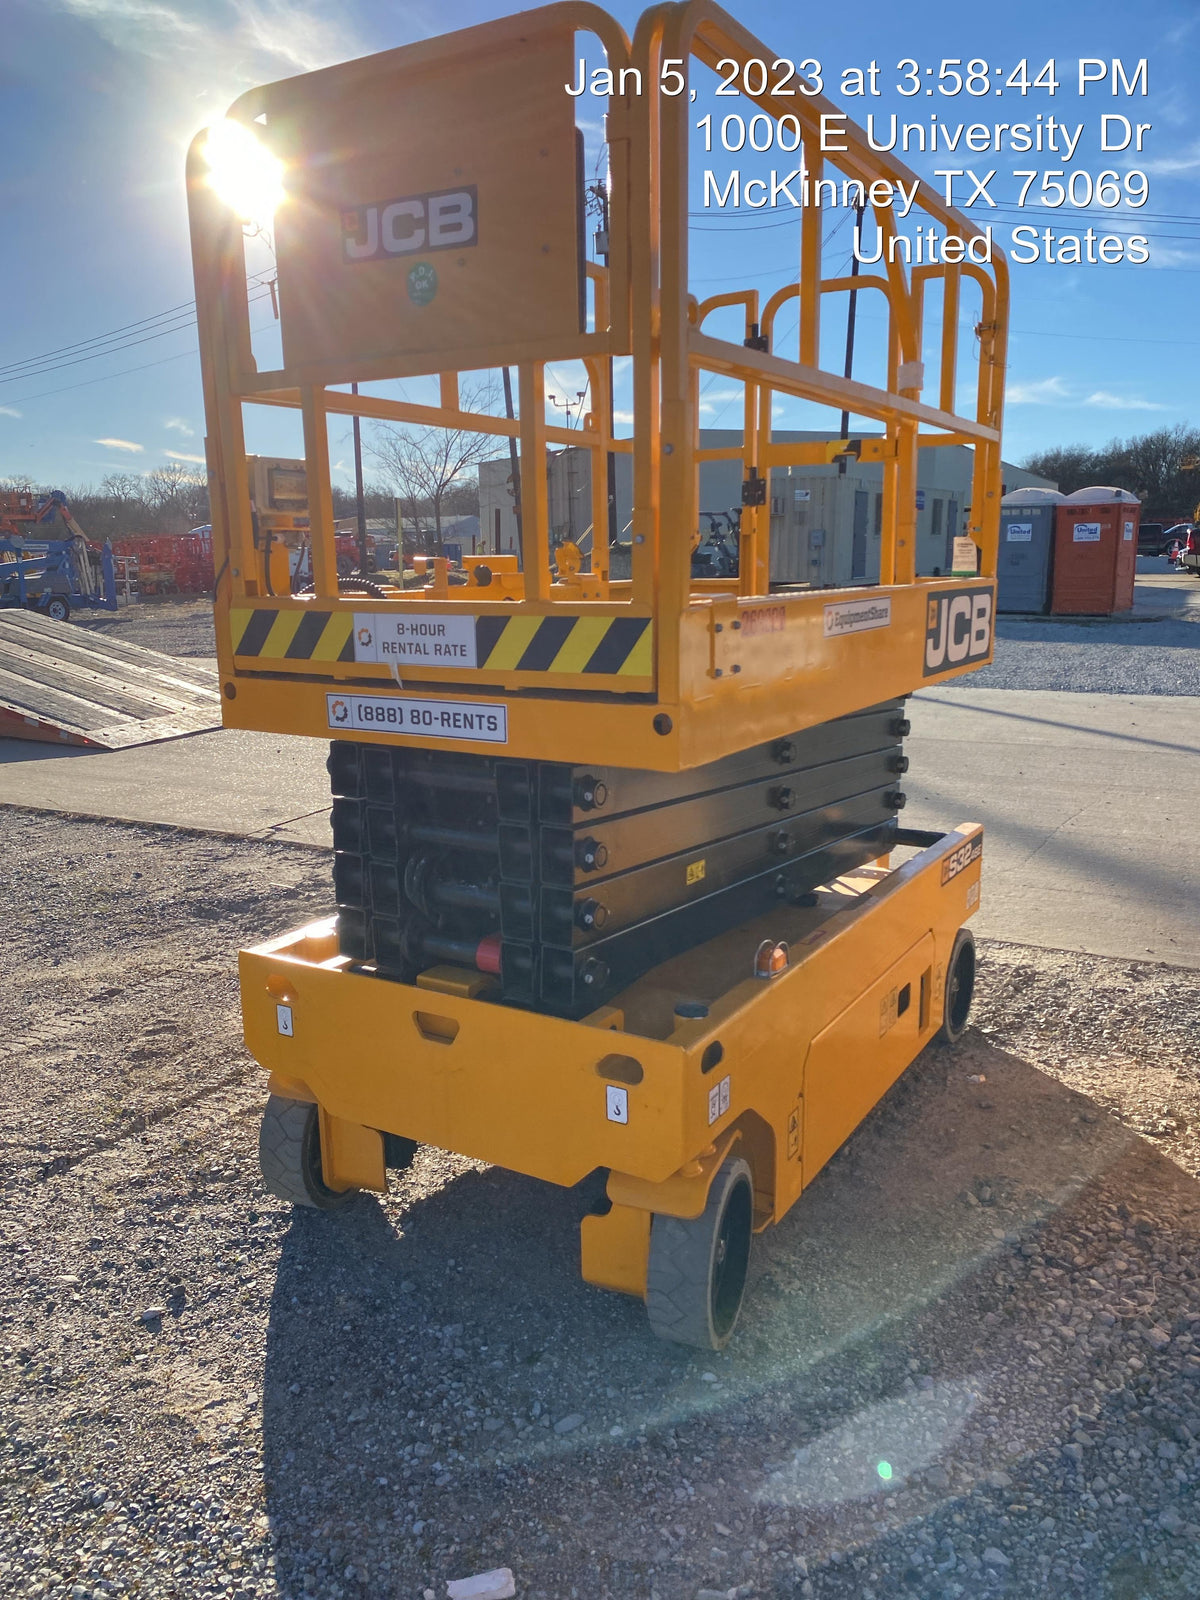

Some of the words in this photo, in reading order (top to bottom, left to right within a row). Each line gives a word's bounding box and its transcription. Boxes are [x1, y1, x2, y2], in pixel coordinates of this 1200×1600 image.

[345, 192, 475, 259] JCB
[1076, 526, 1098, 534] United
[396, 623, 446, 637] 8-HOUR
[834, 606, 889, 629] EquipmentShare
[926, 593, 992, 668] JCB
[382, 641, 430, 656] RENTAL
[434, 643, 468, 657] RATE
[357, 704, 403, 725] (888)
[410, 709, 498, 732] 80-RENTS
[949, 842, 972, 878] S32
